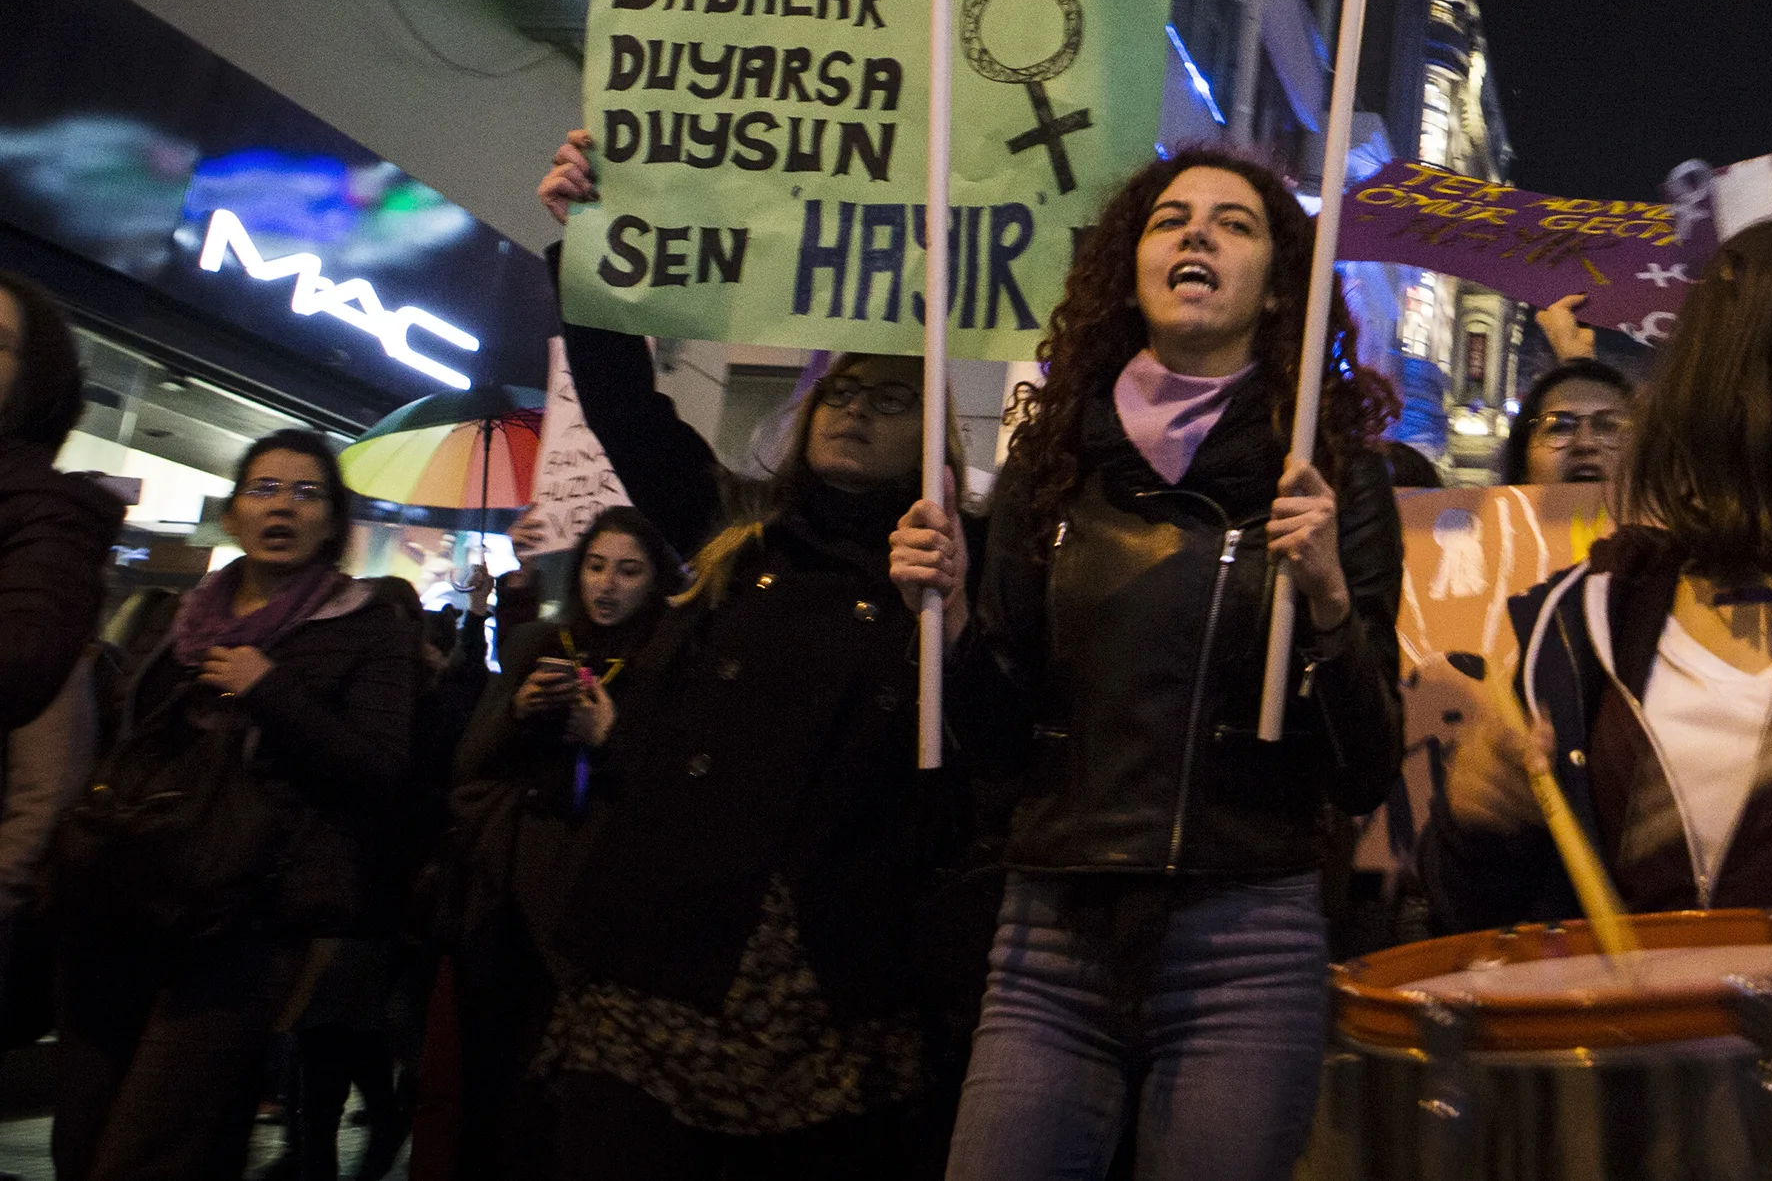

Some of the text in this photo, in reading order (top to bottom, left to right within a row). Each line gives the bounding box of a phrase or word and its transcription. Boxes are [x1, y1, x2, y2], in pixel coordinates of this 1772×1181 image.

[604, 34, 905, 112] DUYARSA
[602, 109, 898, 182] DUYSUN
[1356, 182, 1518, 226] ÖMÜR
[1405, 164, 1518, 203] TEK
[597, 213, 750, 289] SEN
